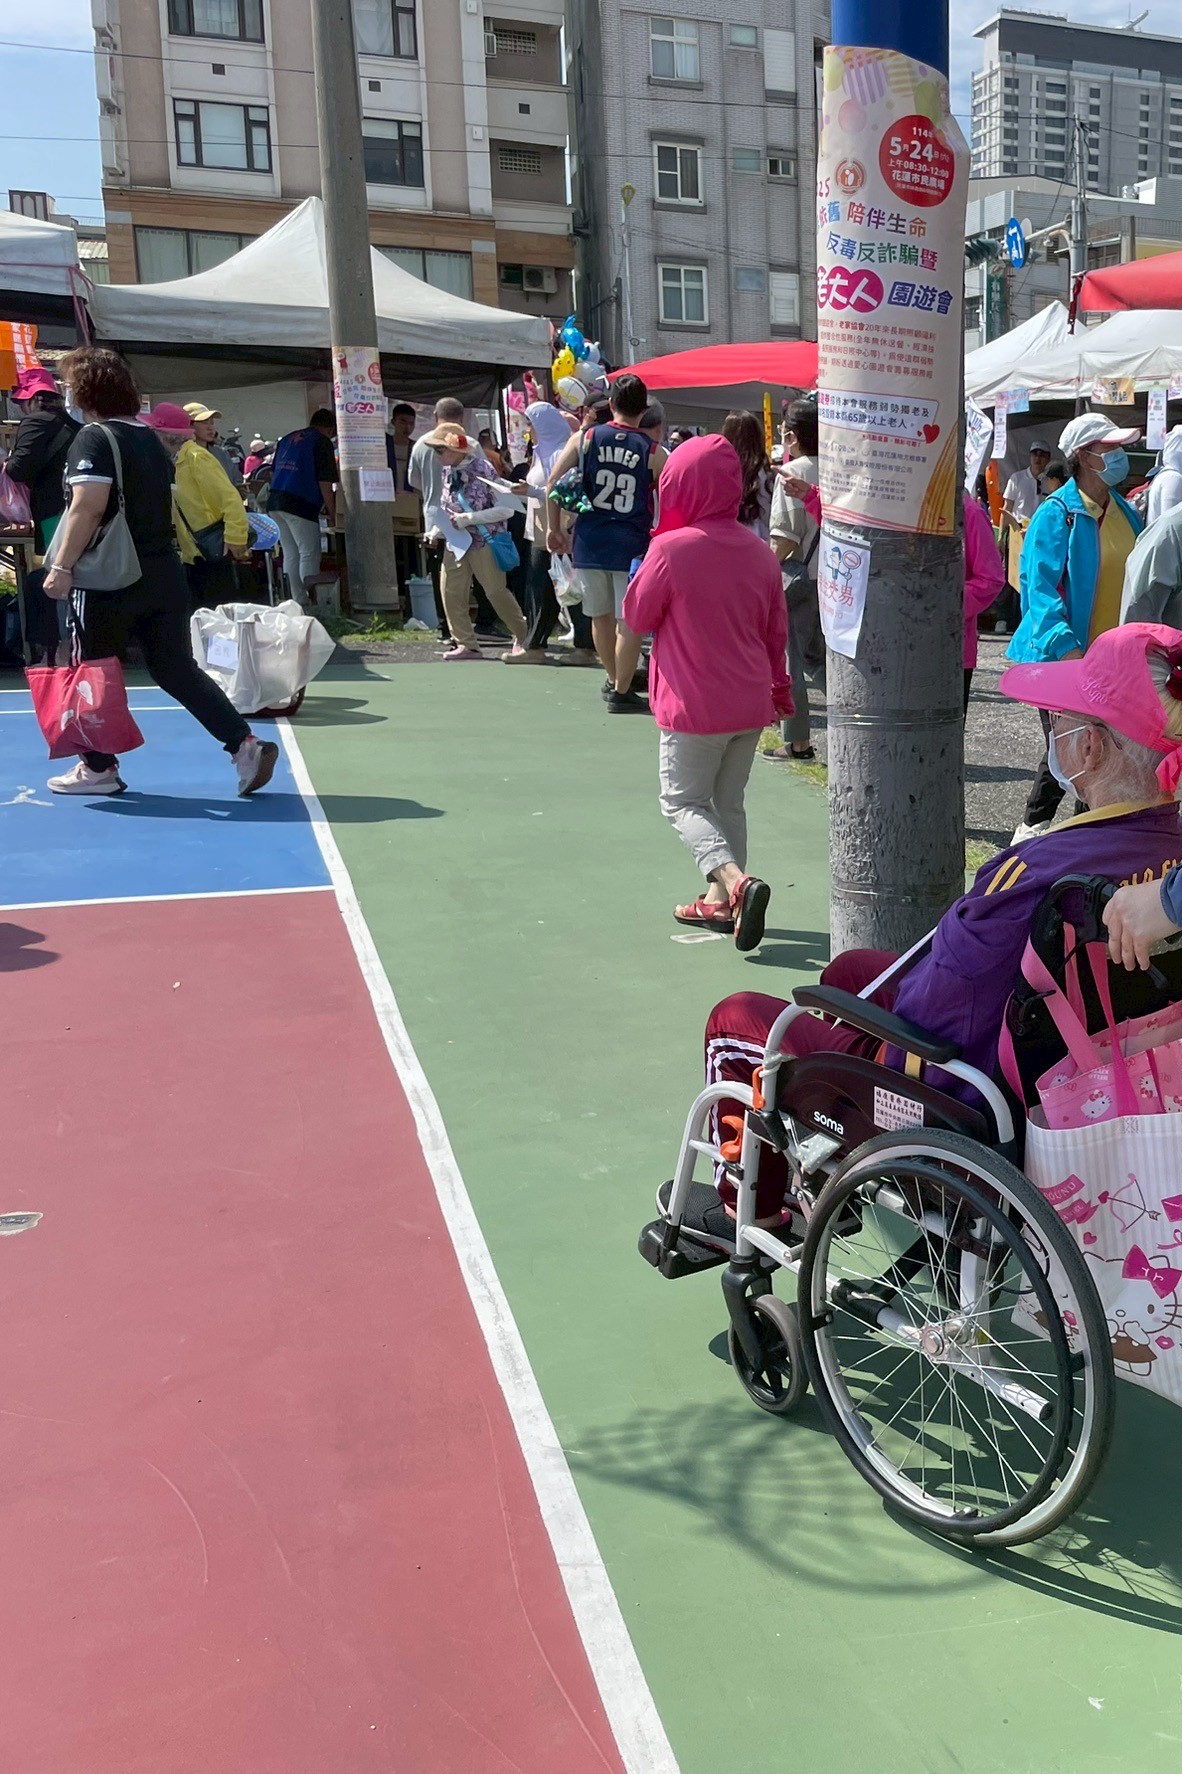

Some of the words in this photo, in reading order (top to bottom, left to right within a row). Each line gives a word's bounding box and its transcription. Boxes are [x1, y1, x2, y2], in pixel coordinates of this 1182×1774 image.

[847, 201, 927, 238] 陪伴生命
[826, 231, 938, 271] 反毒反詐騙暨
[887, 281, 953, 315] 園遊會
[597, 445, 640, 469] JAMES
[592, 468, 637, 513] 23
[813, 1110, 844, 1135] soma
